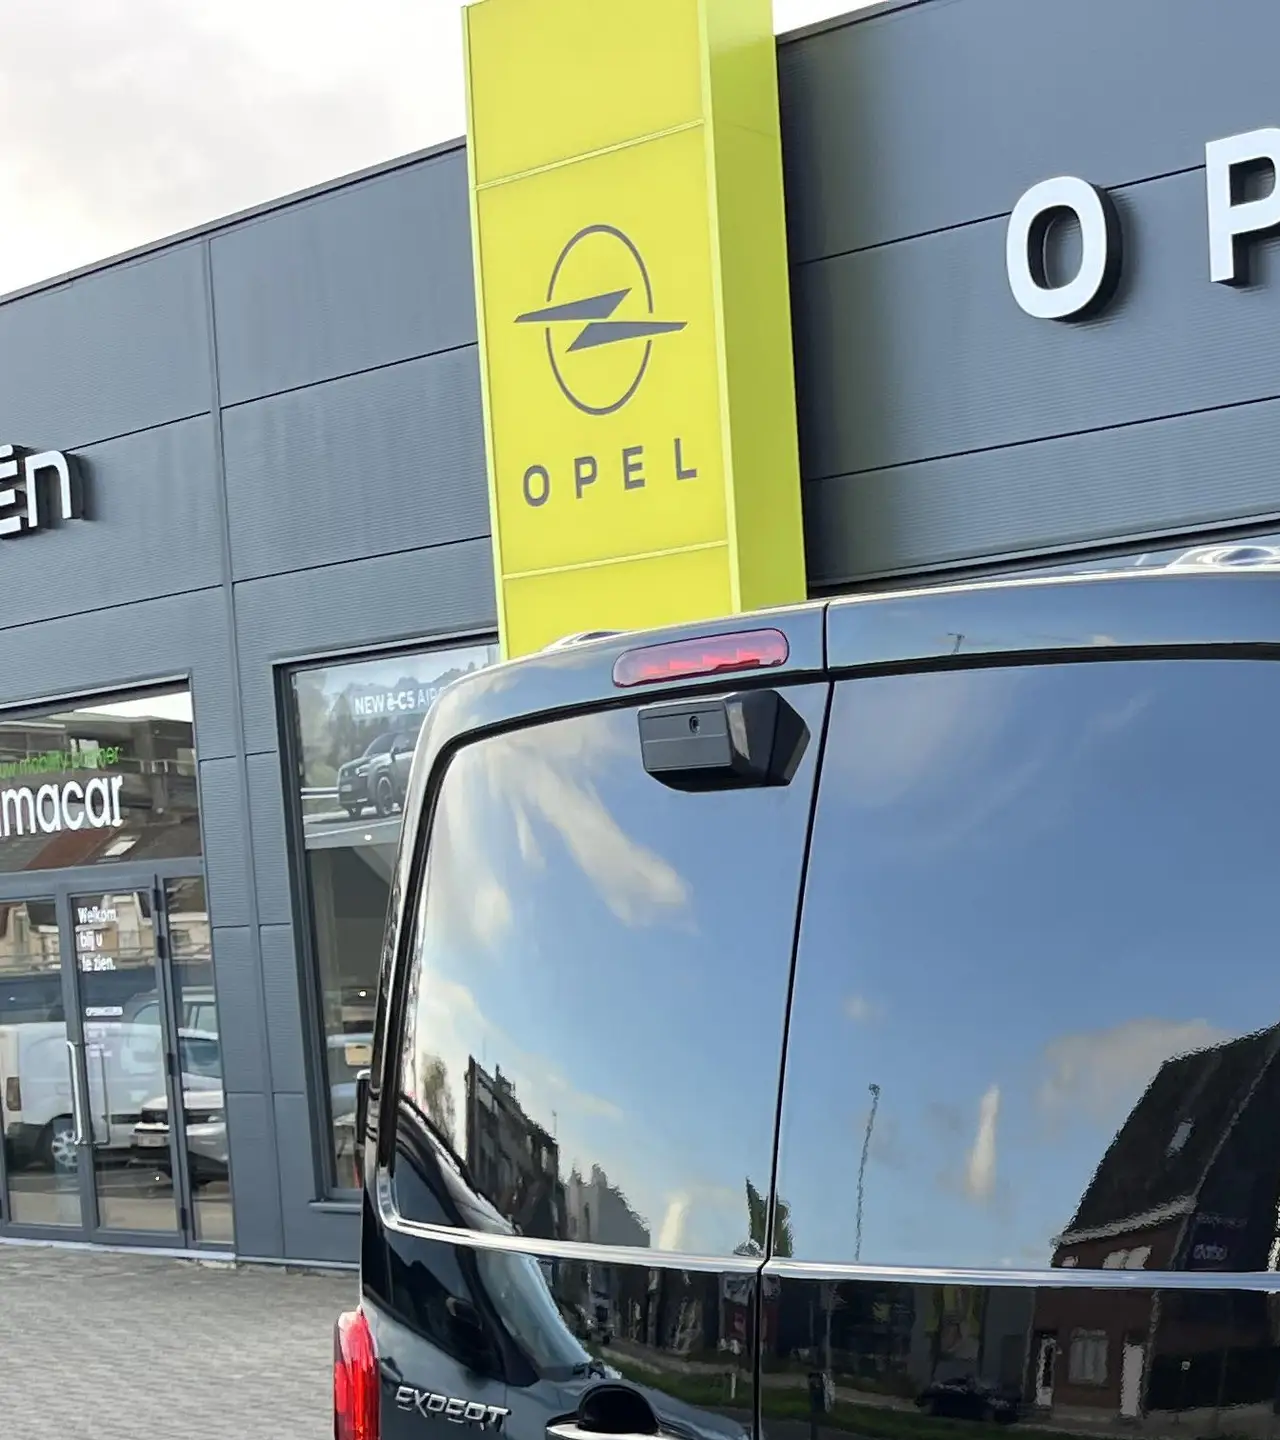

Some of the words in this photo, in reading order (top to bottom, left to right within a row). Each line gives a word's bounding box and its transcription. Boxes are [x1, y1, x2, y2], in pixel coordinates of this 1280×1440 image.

[522, 438, 697, 507] OPEL
[355, 693, 385, 715] NEW
[0, 775, 123, 838] macar
[395, 1385, 510, 1432] EXPERT
